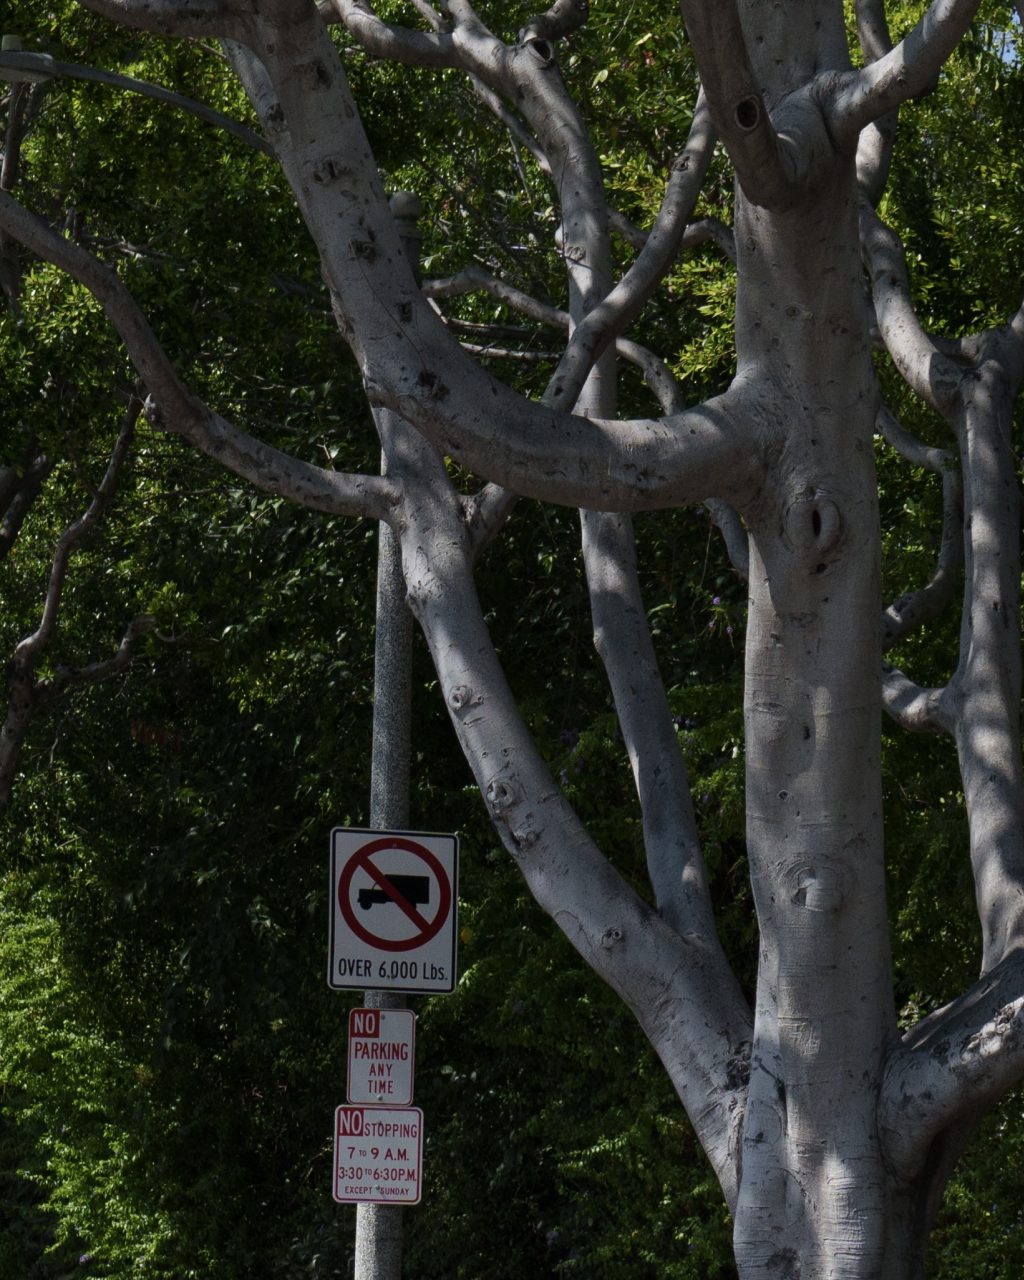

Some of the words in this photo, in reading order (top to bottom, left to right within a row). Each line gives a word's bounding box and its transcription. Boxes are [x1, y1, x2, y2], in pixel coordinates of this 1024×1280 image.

[338, 958, 372, 977] OVER
[378, 960, 418, 980] 6,000
[354, 1012, 376, 1034] NO
[355, 1041, 409, 1061] PARKING
[369, 1064, 393, 1077] ANY
[368, 1080, 394, 1094] TIME
[340, 1110, 363, 1135] NO
[364, 1123, 417, 1138] STOPPING
[347, 1147, 356, 1159] 7
[371, 1147, 379, 1159] 9
[384, 1148, 409, 1161] A.M.
[338, 1167, 363, 1180] 3:30
[345, 1186, 372, 1195] EXCEPT
[380, 1186, 409, 1195] SUNDAY
